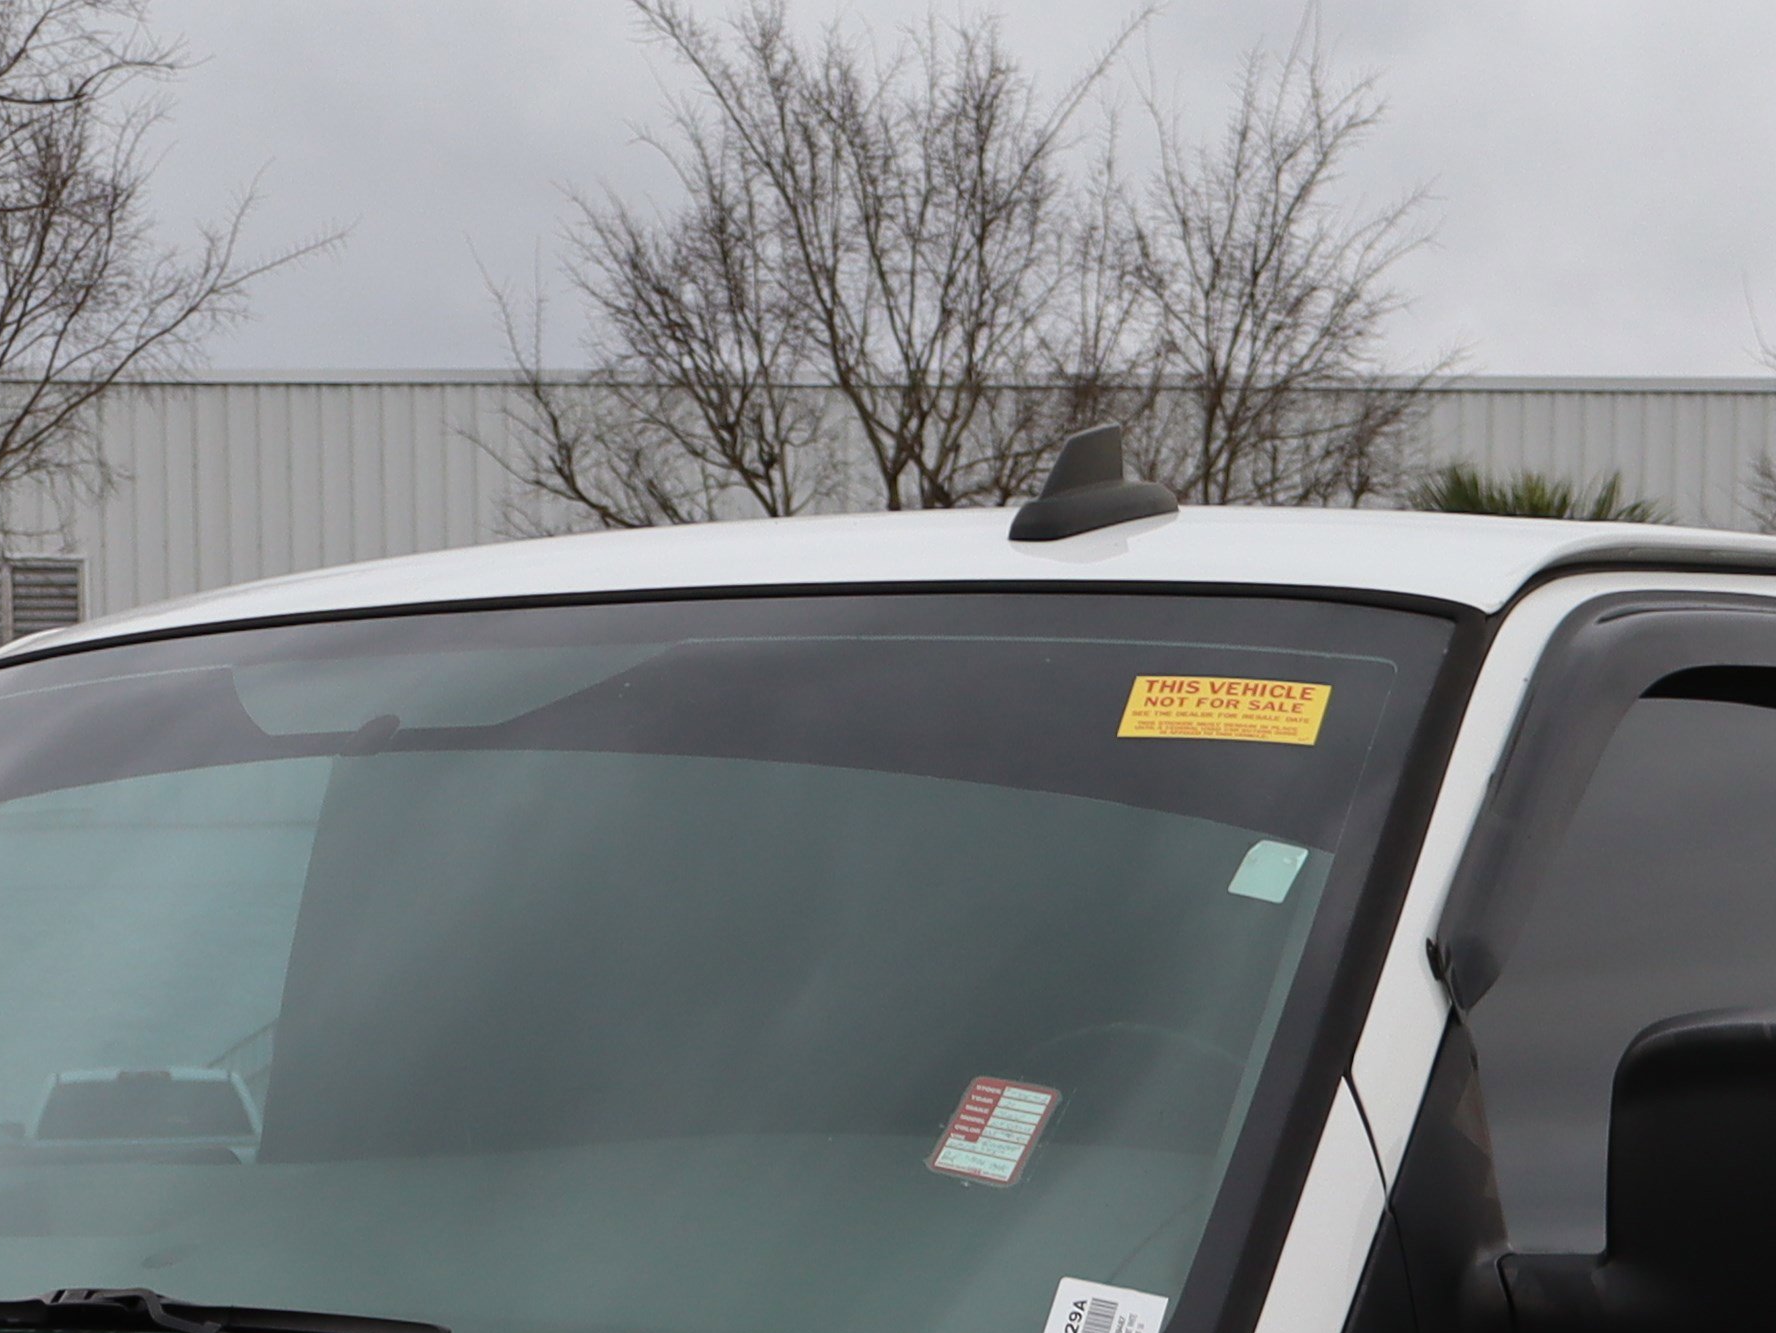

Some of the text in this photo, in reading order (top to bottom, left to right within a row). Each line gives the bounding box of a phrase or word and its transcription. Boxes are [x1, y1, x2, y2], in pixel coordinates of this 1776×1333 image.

[1145, 679, 1316, 701] THIS VEHICLE
[1144, 696, 1304, 714] NOT FOR SALE
